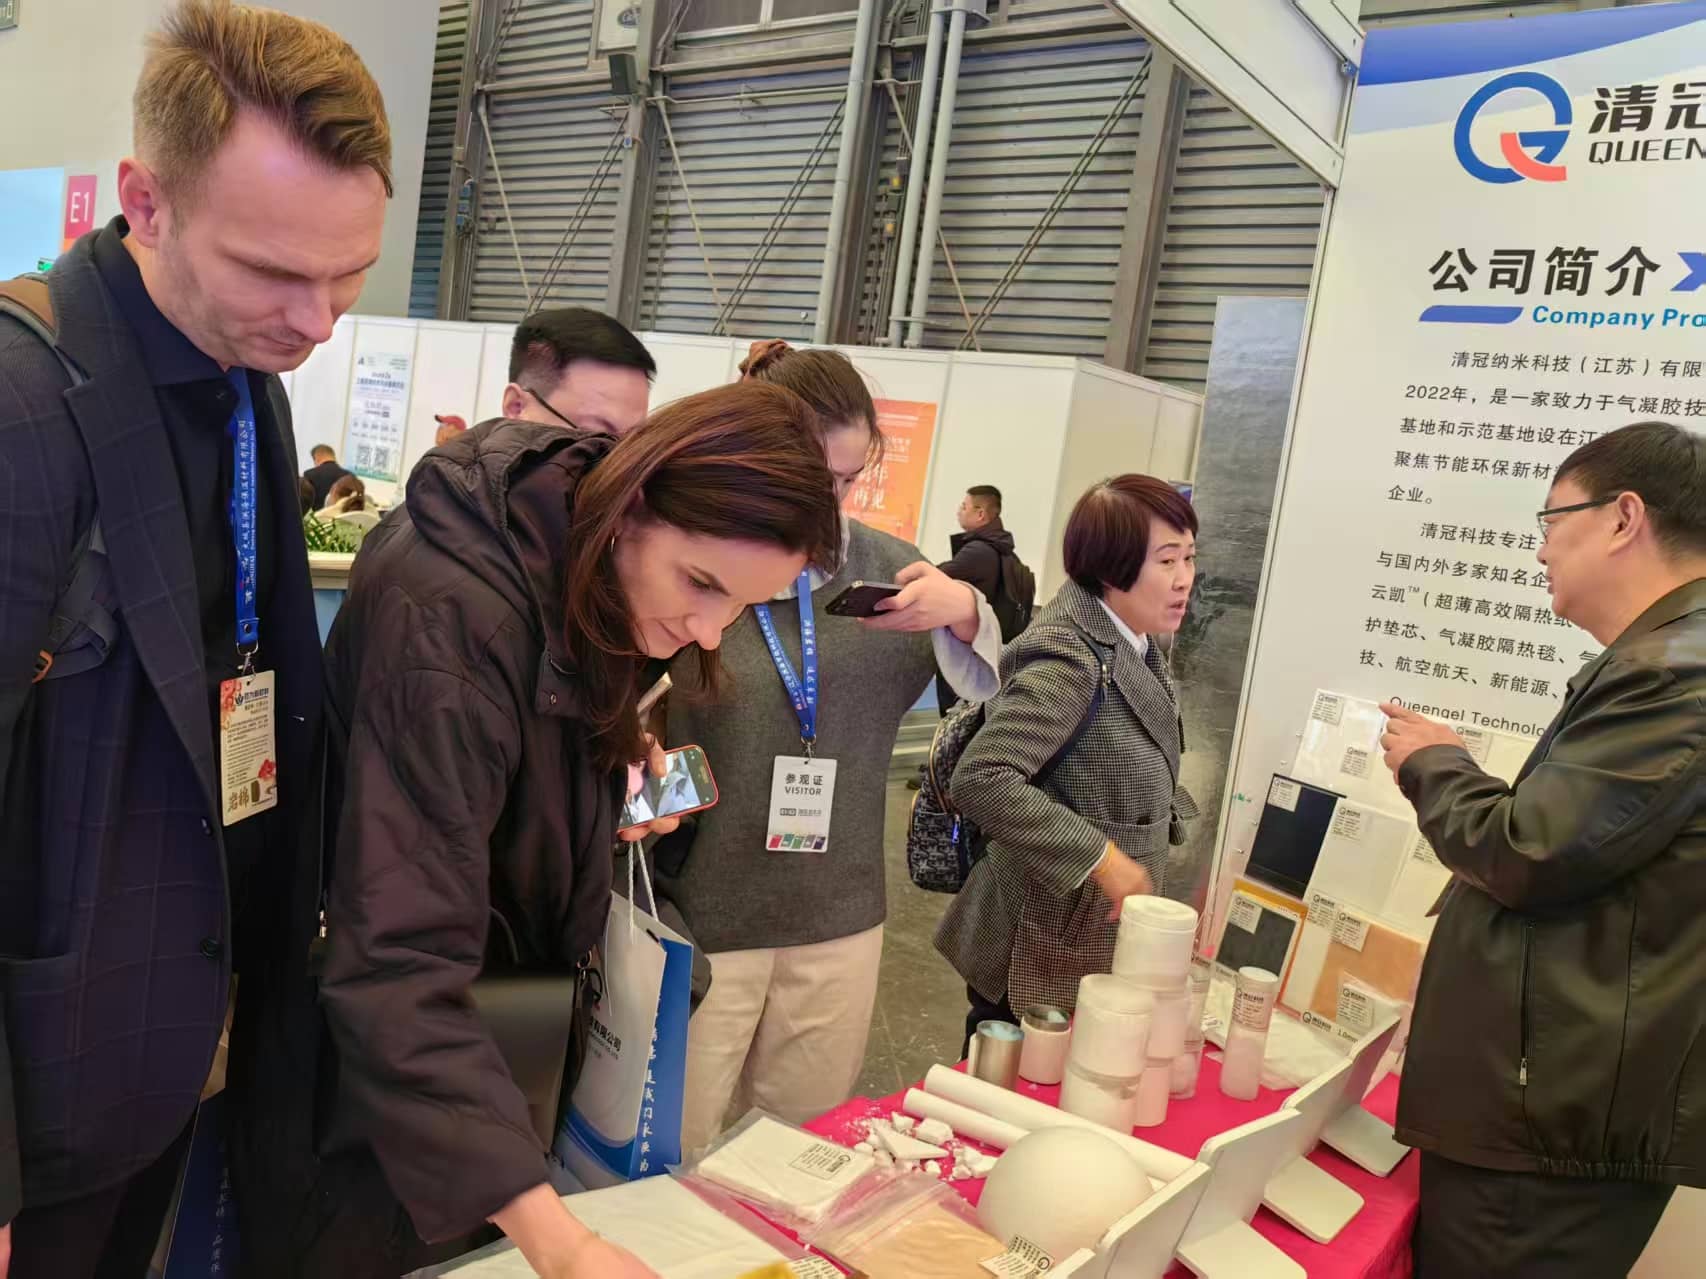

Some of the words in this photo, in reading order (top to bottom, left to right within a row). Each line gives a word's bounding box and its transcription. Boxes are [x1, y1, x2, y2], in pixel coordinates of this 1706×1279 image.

[70, 191, 90, 224] E1
[1428, 246, 1662, 297] 公司简介
[1533, 305, 1655, 330] Company
[1393, 450, 1560, 480] 聚焦节能环保新材
[1387, 484, 1433, 505] 企业。
[1420, 522, 1545, 551] 清冠科技专注
[785, 773, 823, 786] 参观证
[785, 786, 822, 796] VISITOR
